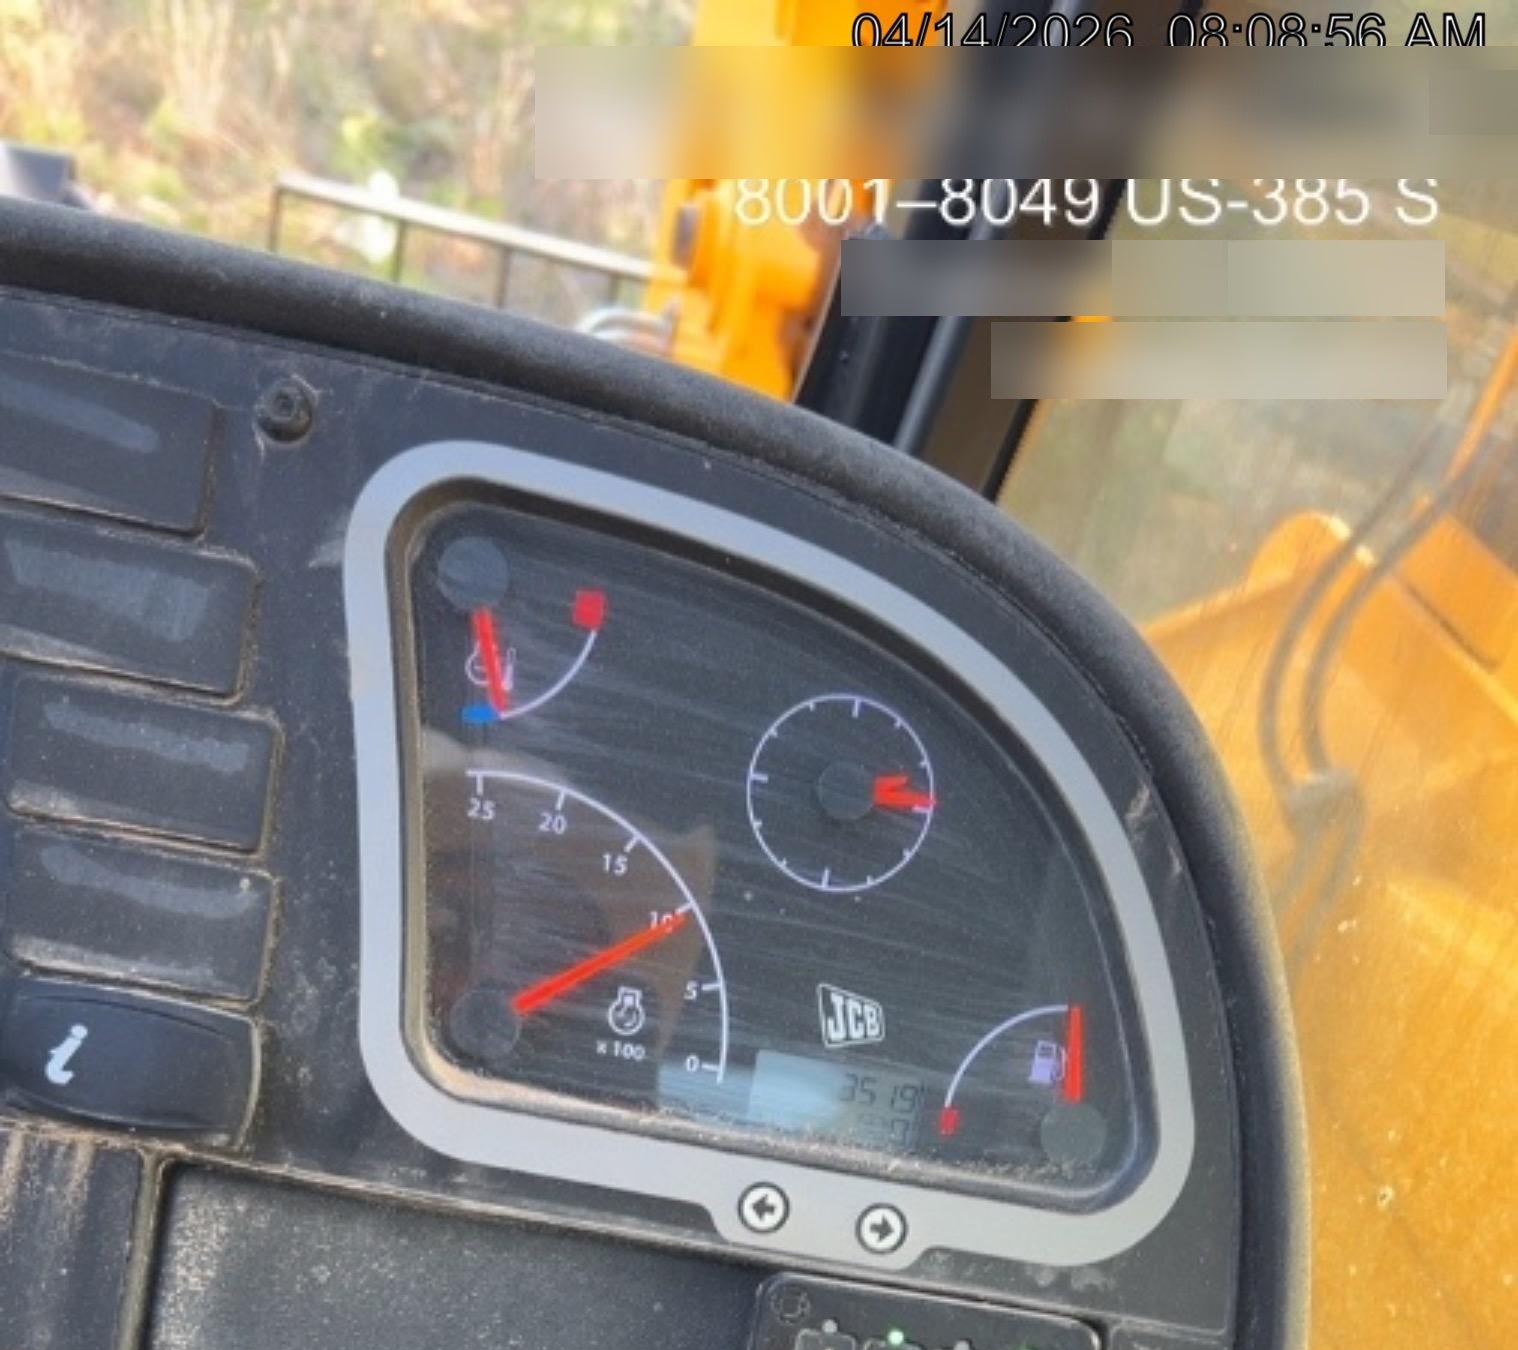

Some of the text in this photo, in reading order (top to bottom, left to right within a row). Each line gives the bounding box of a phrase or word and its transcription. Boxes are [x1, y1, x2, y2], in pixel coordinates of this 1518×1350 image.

[467, 800, 495, 820] 25
[538, 813, 567, 835] 20
[602, 854, 628, 875] 15
[684, 983, 698, 1000] 5
[824, 993, 883, 1042] JCB
[613, 1041, 646, 1060] 100
[686, 1057, 698, 1073] 0
